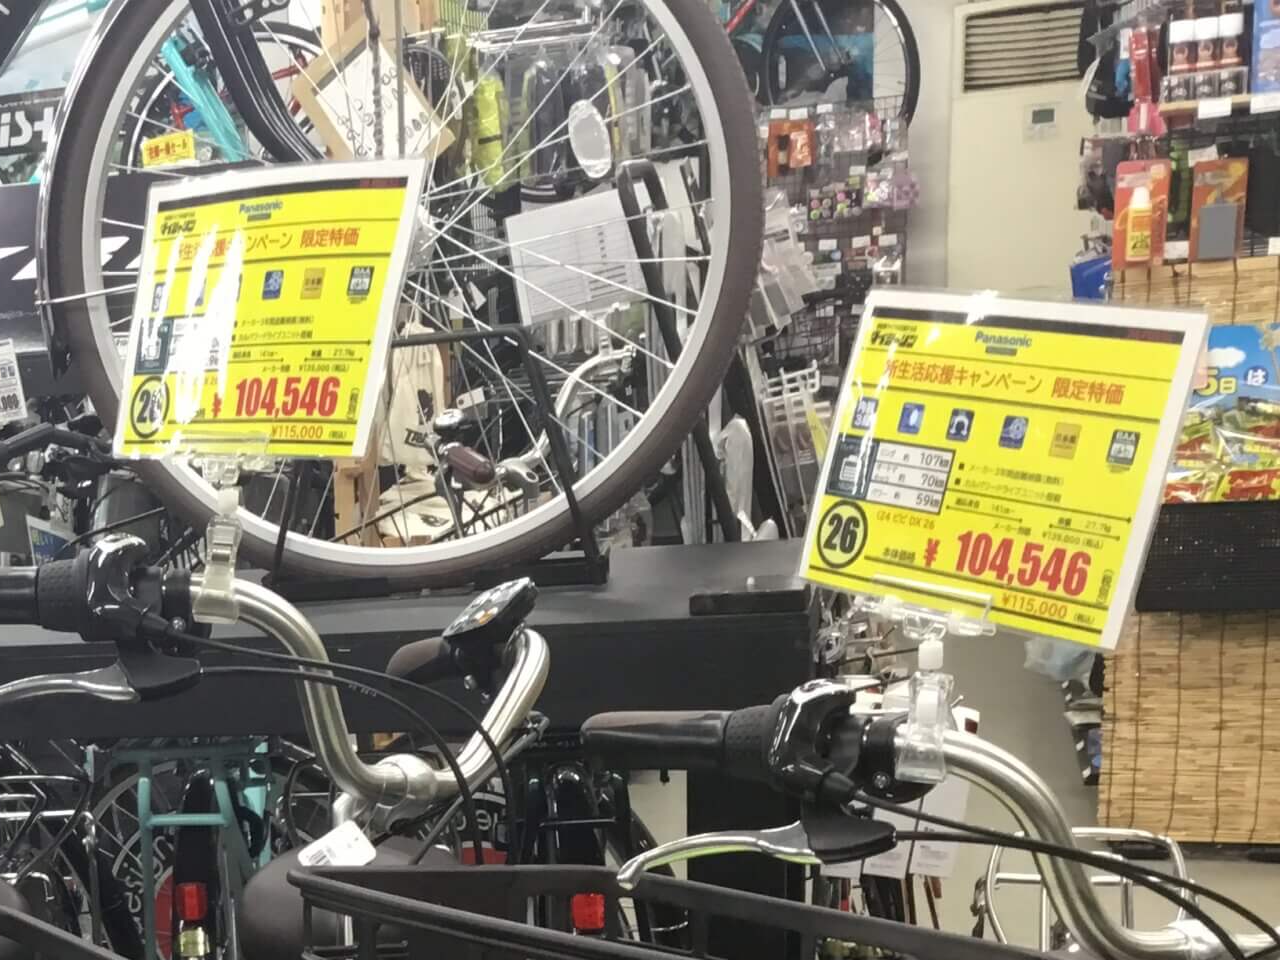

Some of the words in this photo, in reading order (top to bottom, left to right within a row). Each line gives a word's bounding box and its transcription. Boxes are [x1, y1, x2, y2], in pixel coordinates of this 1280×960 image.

[300, 227, 360, 248] 限定特価
[974, 331, 1033, 348] Panasonic
[236, 376, 340, 418] 104,546
[1051, 376, 1126, 405] 限定特価
[271, 425, 324, 439] ¥115,000
[823, 513, 859, 554] 26
[955, 530, 1091, 597] 104,546
[1002, 592, 1067, 619] ¥115,000
